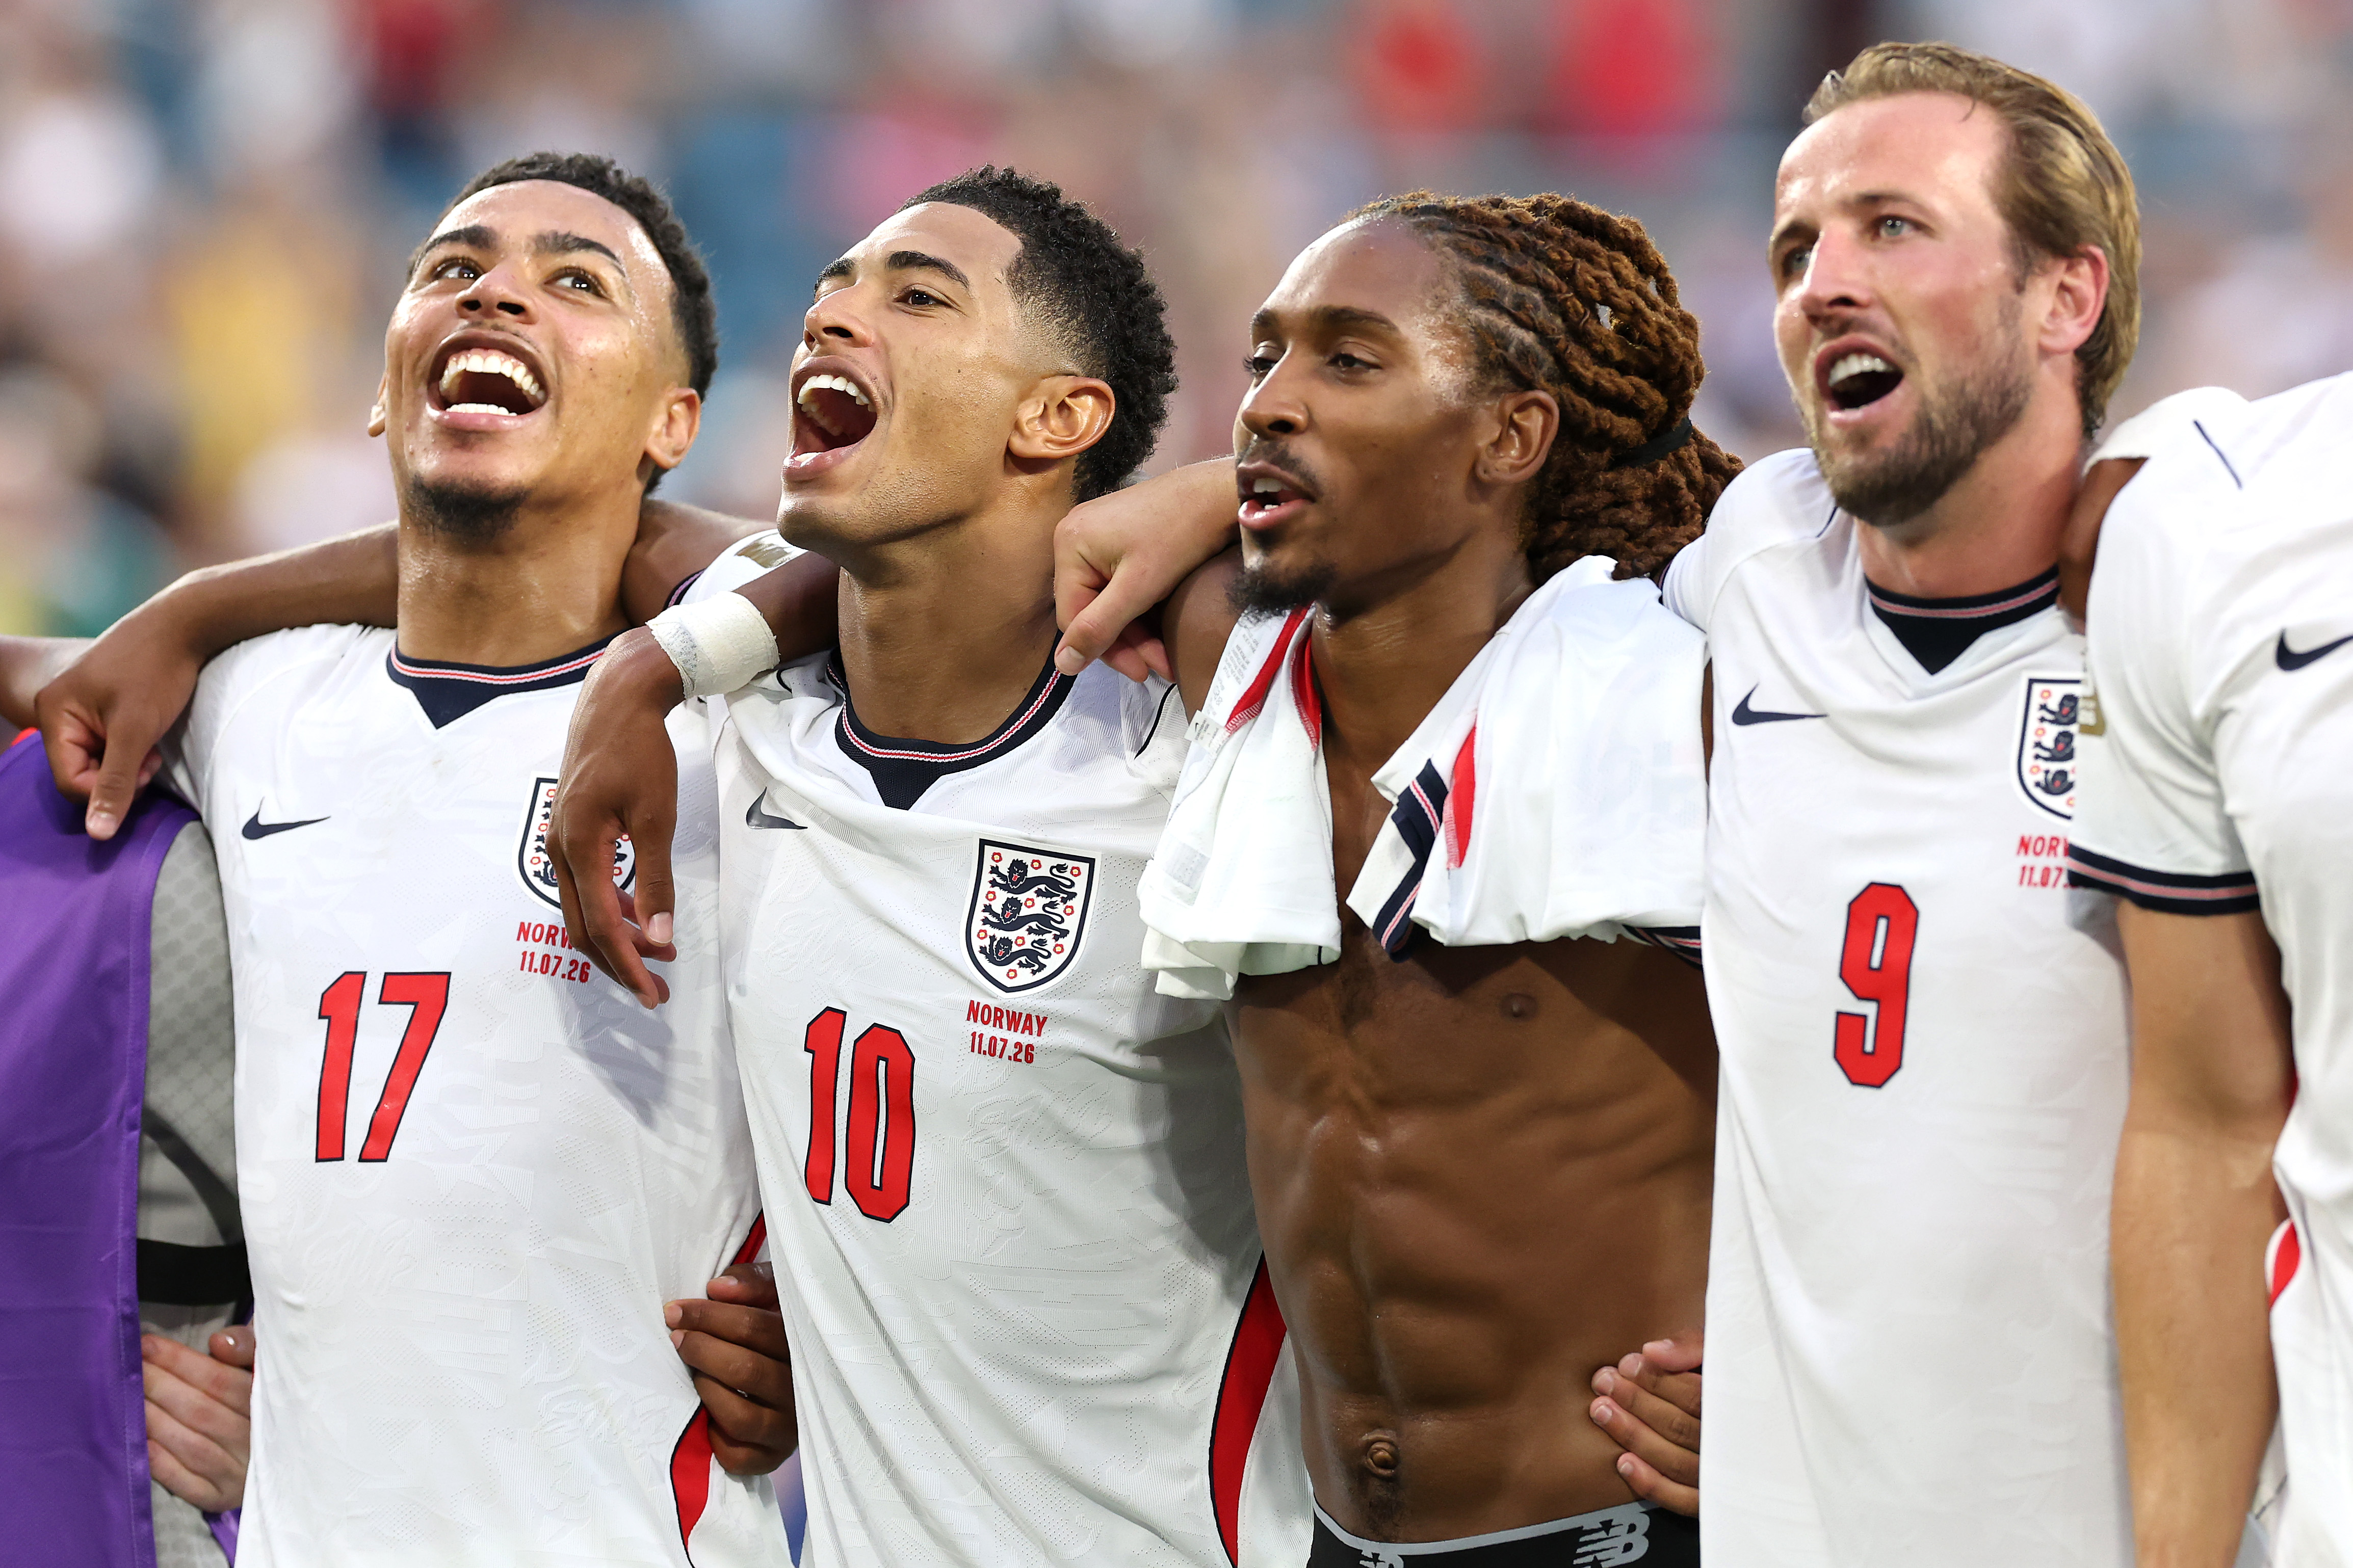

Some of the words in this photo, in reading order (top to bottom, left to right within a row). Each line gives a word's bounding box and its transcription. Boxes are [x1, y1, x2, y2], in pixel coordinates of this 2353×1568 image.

[2019, 865, 2079, 888] 11.07.
[520, 950, 591, 983] 11.07.26
[1833, 882, 1920, 1088] 9
[966, 1000, 1048, 1037] NORWAY
[971, 1031, 1035, 1064] 11.07.26
[315, 971, 451, 1162] 17
[803, 1007, 916, 1222] 10
